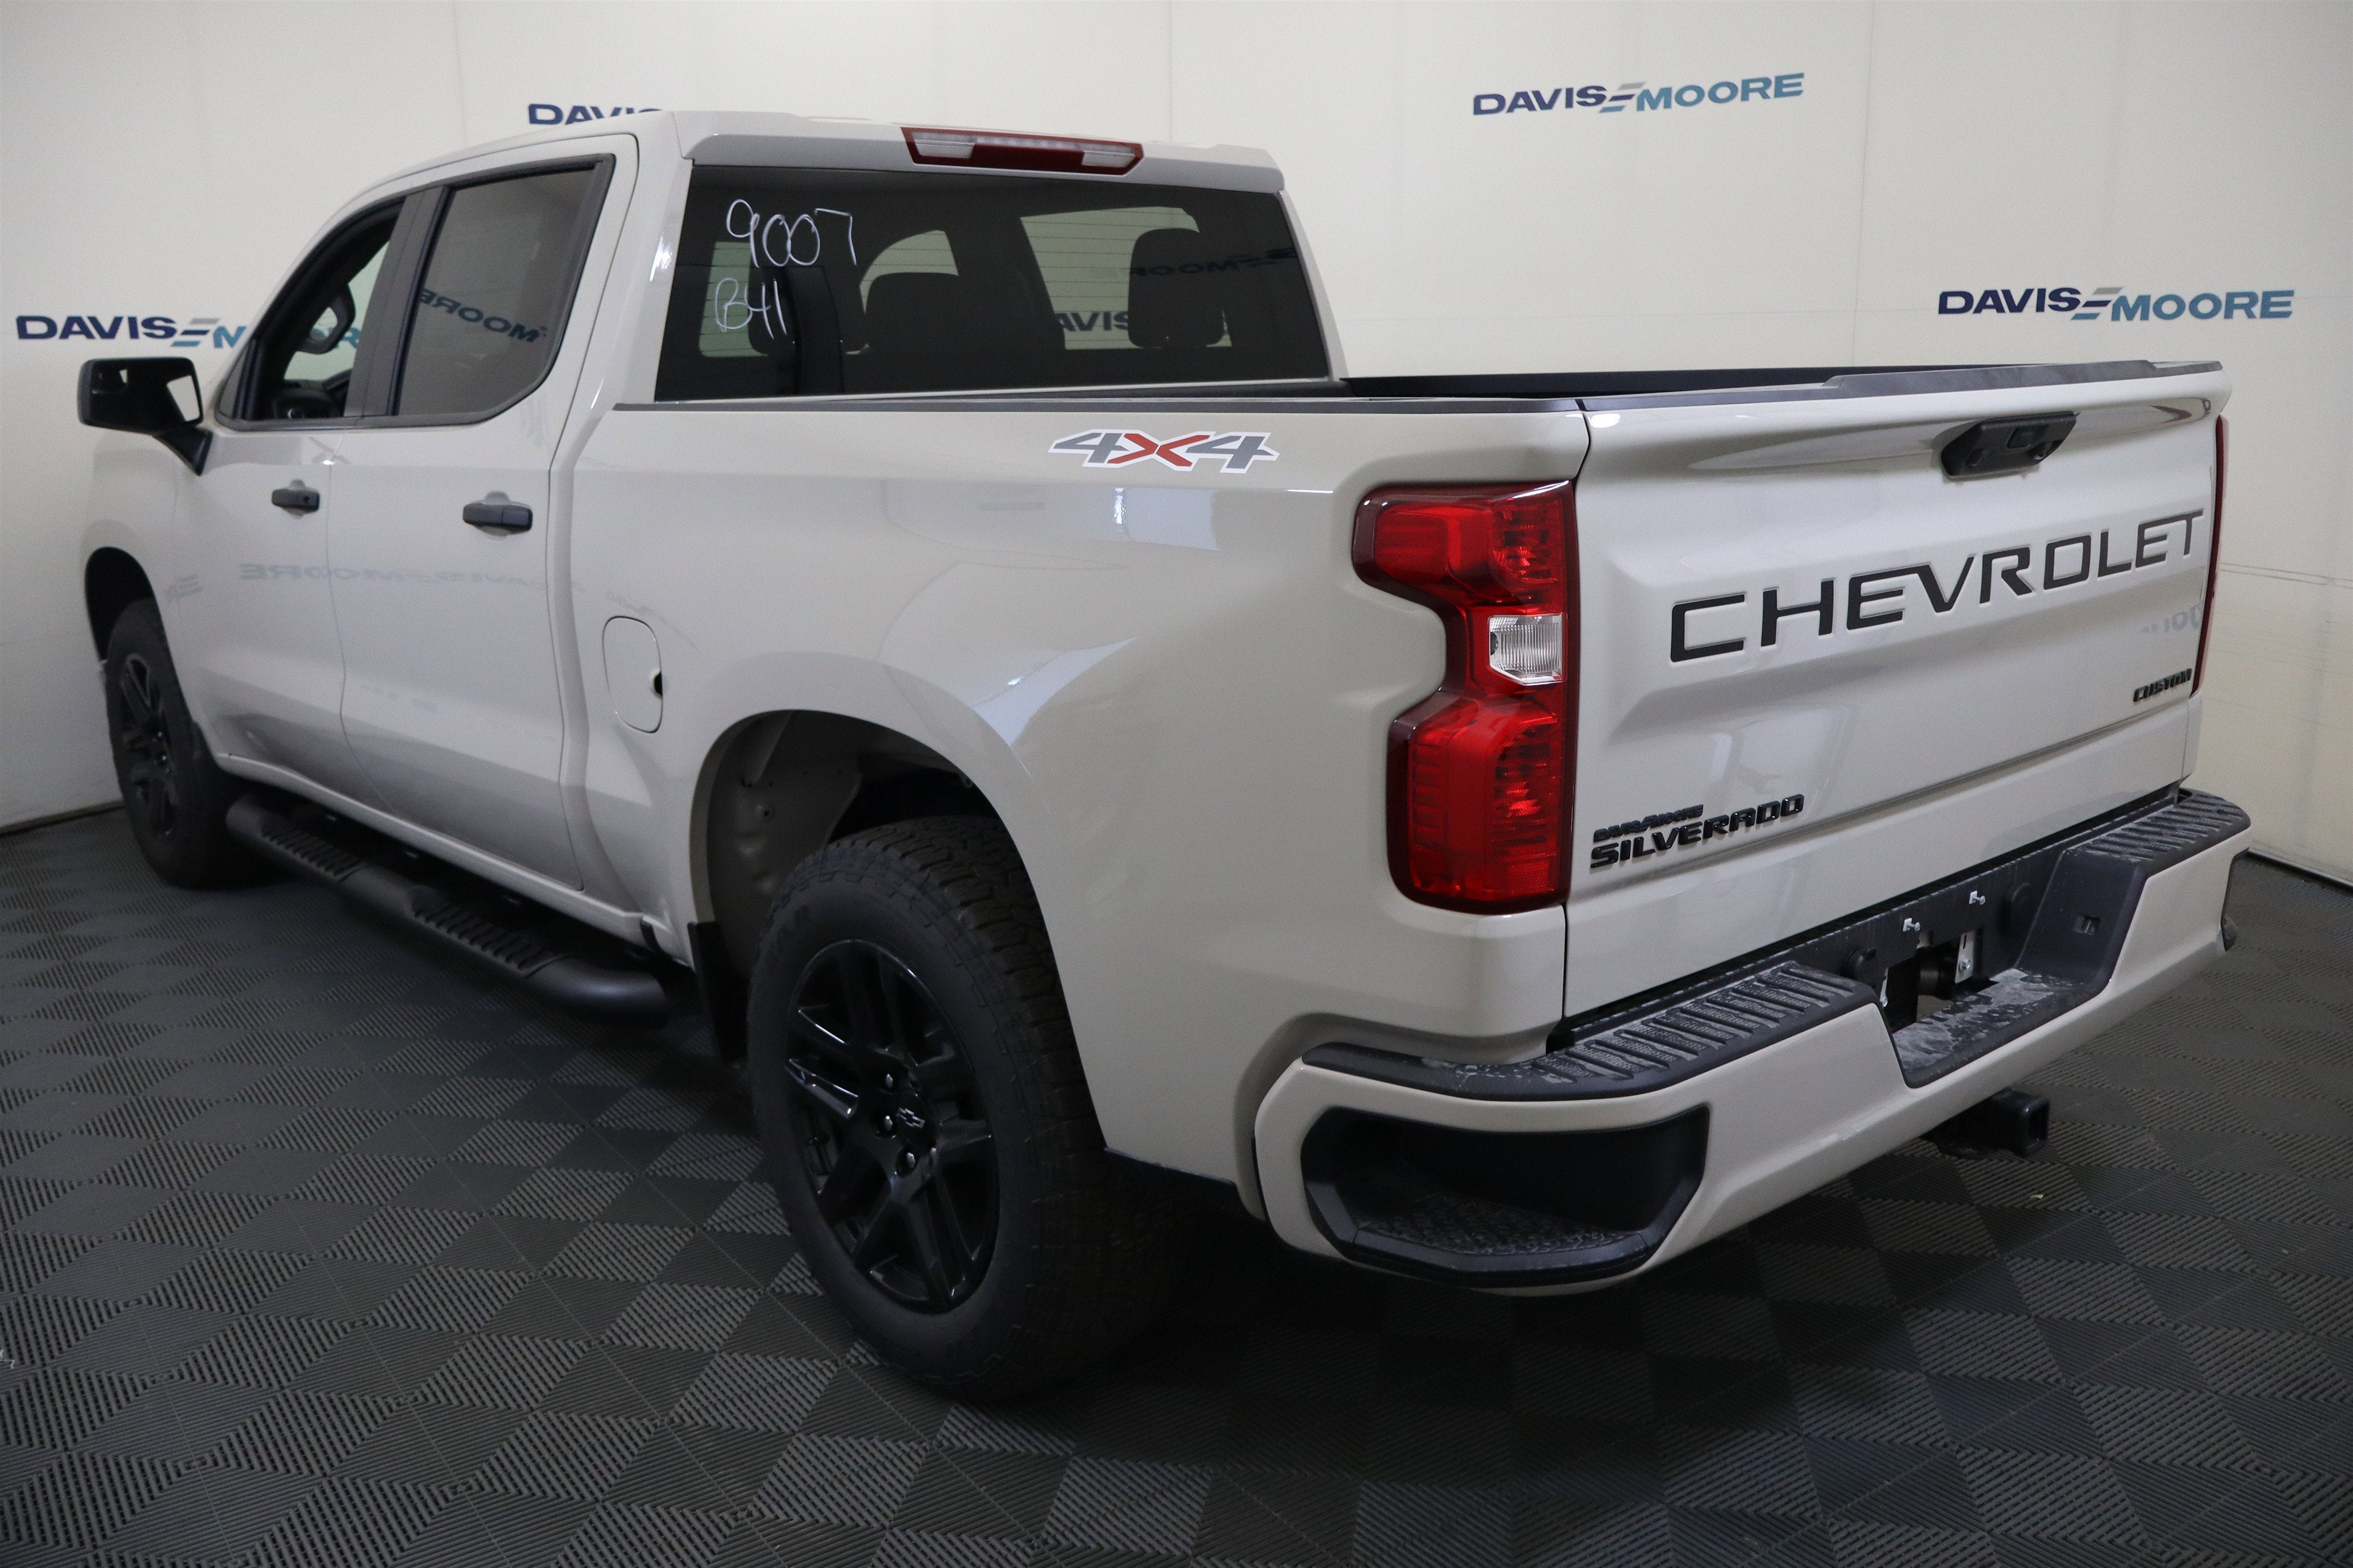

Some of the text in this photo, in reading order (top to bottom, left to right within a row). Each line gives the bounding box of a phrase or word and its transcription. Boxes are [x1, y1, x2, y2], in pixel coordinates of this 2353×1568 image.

[1473, 73, 1804, 115] DAVIS MOORE
[726, 199, 857, 268] 9007
[16, 315, 177, 340] DAVIS
[1938, 288, 2294, 322] DAVIS MOORE
[1670, 508, 2203, 663] CHEVROLET
[1590, 794, 1804, 868] SILVERADO
